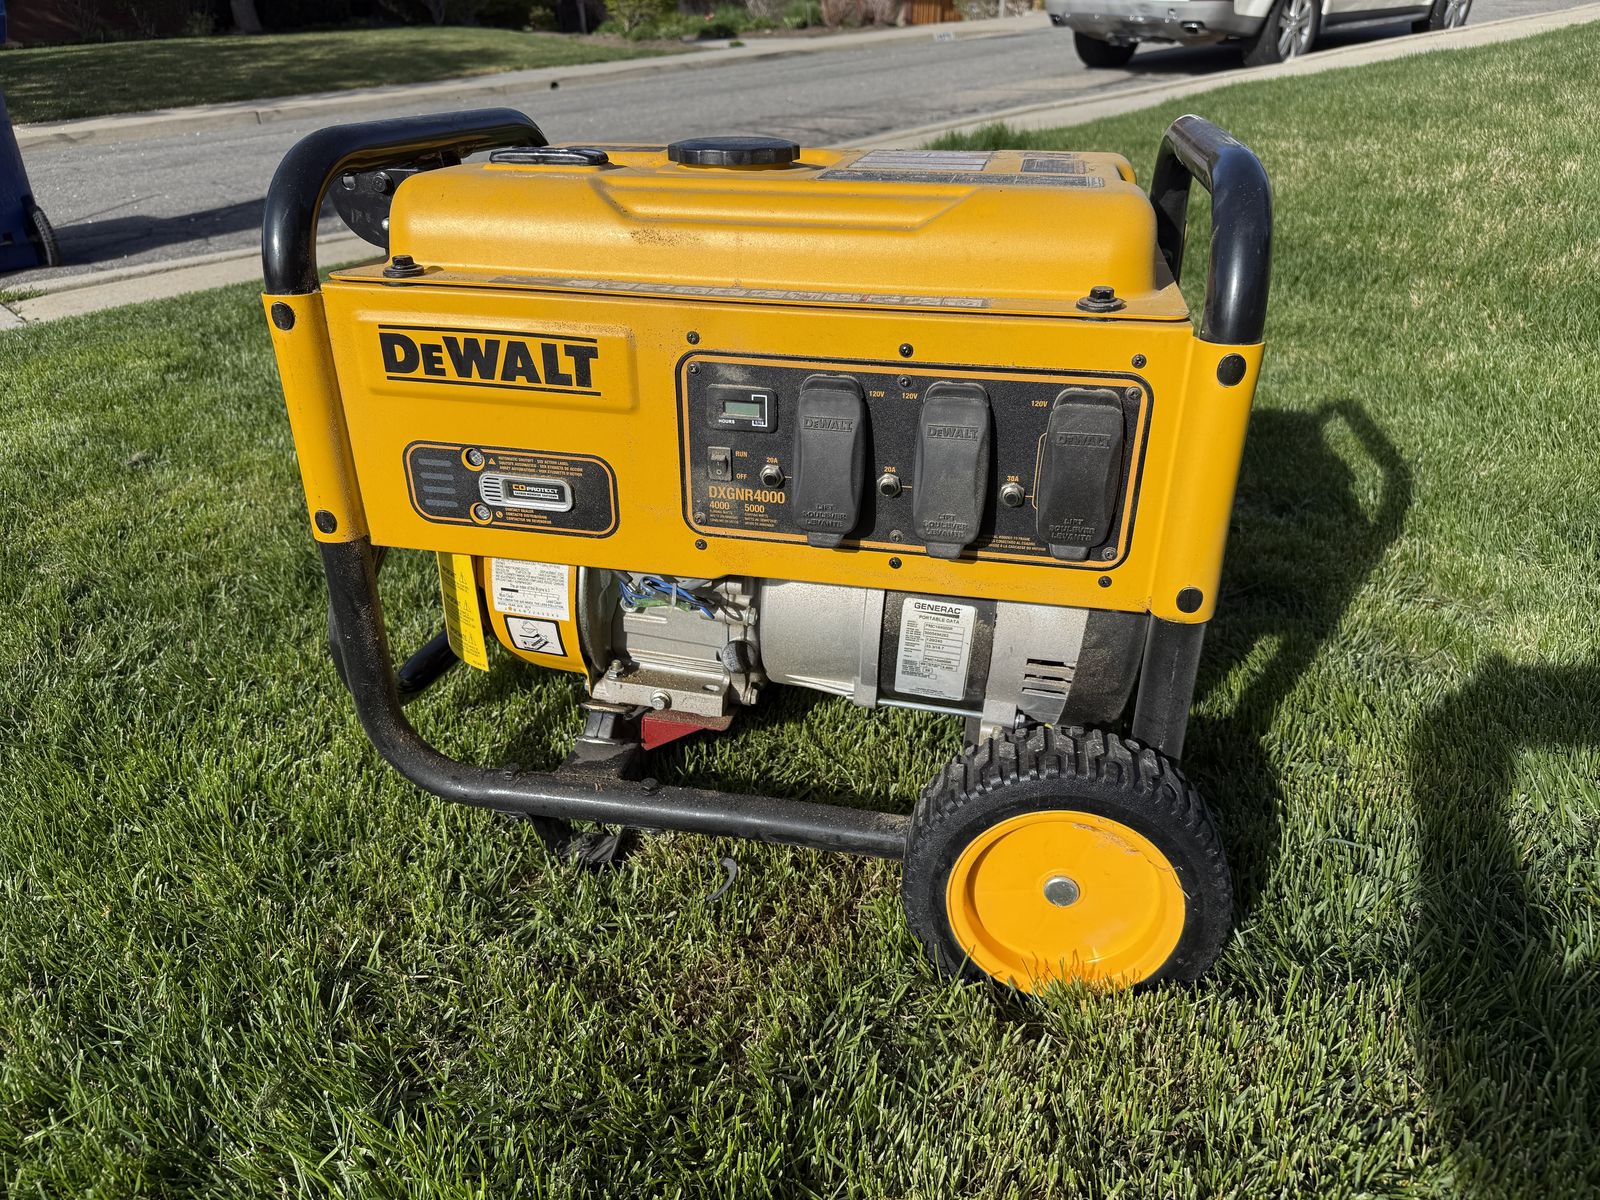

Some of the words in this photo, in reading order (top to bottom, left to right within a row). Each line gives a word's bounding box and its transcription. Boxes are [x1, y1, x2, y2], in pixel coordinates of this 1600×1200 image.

[869, 390, 885, 398] 120V
[902, 392, 918, 400] 120V
[1031, 400, 1048, 408] 120V
[708, 485, 786, 504] DXGNR4000
[709, 501, 730, 510] 4000
[744, 503, 765, 513] 5000
[914, 602, 960, 614] GENERAC
